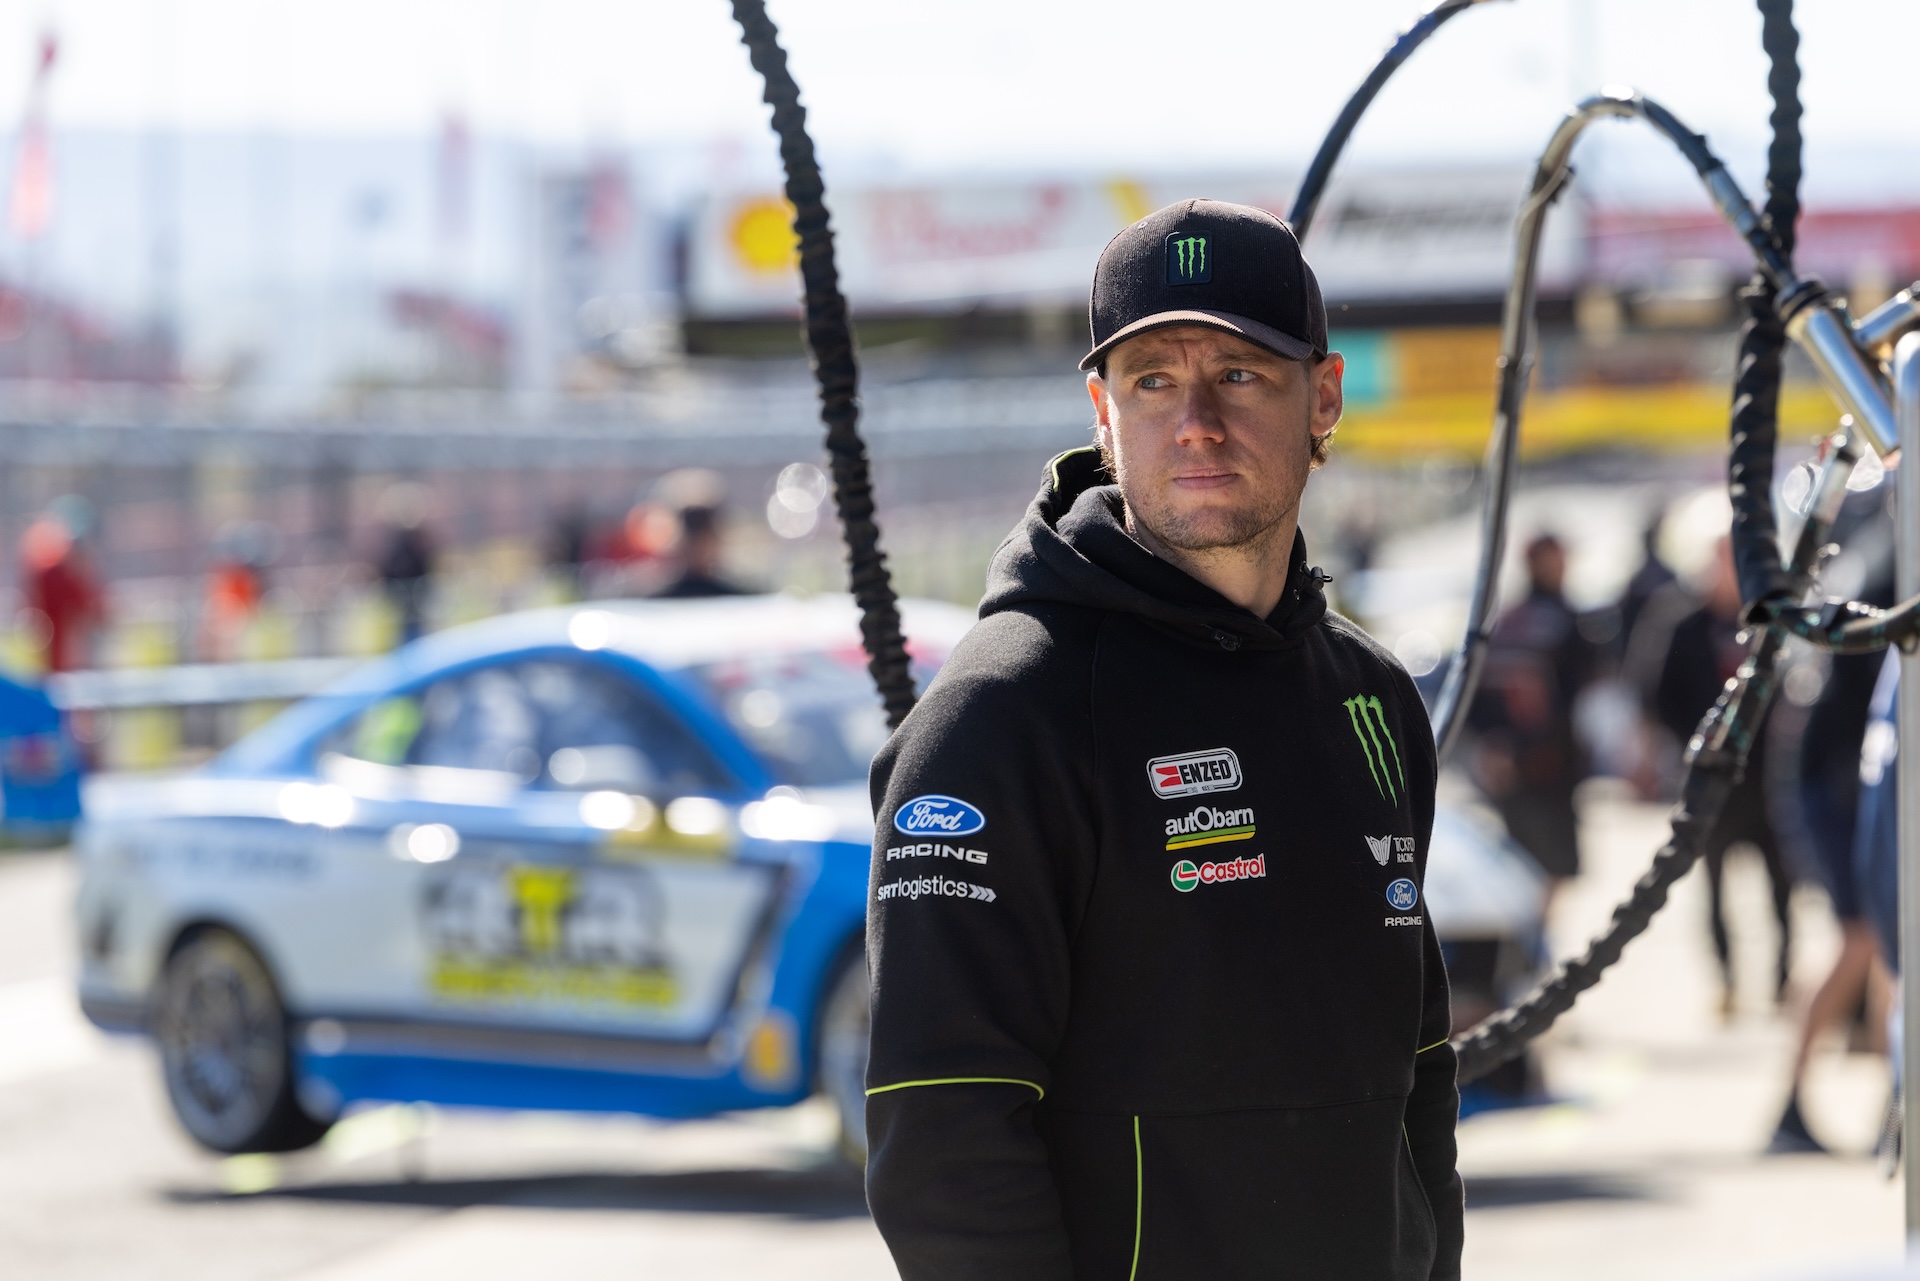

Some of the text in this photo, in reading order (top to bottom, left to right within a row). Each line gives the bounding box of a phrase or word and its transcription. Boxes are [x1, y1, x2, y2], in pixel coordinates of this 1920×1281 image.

[1179, 759, 1232, 785] ENZED
[907, 801, 965, 830] Ford
[886, 843, 988, 865] RACING
[1397, 853, 1414, 863] RACING
[1200, 853, 1266, 882] Castrol
[1393, 883, 1413, 904] Ford
[1385, 916, 1422, 927] RACING
